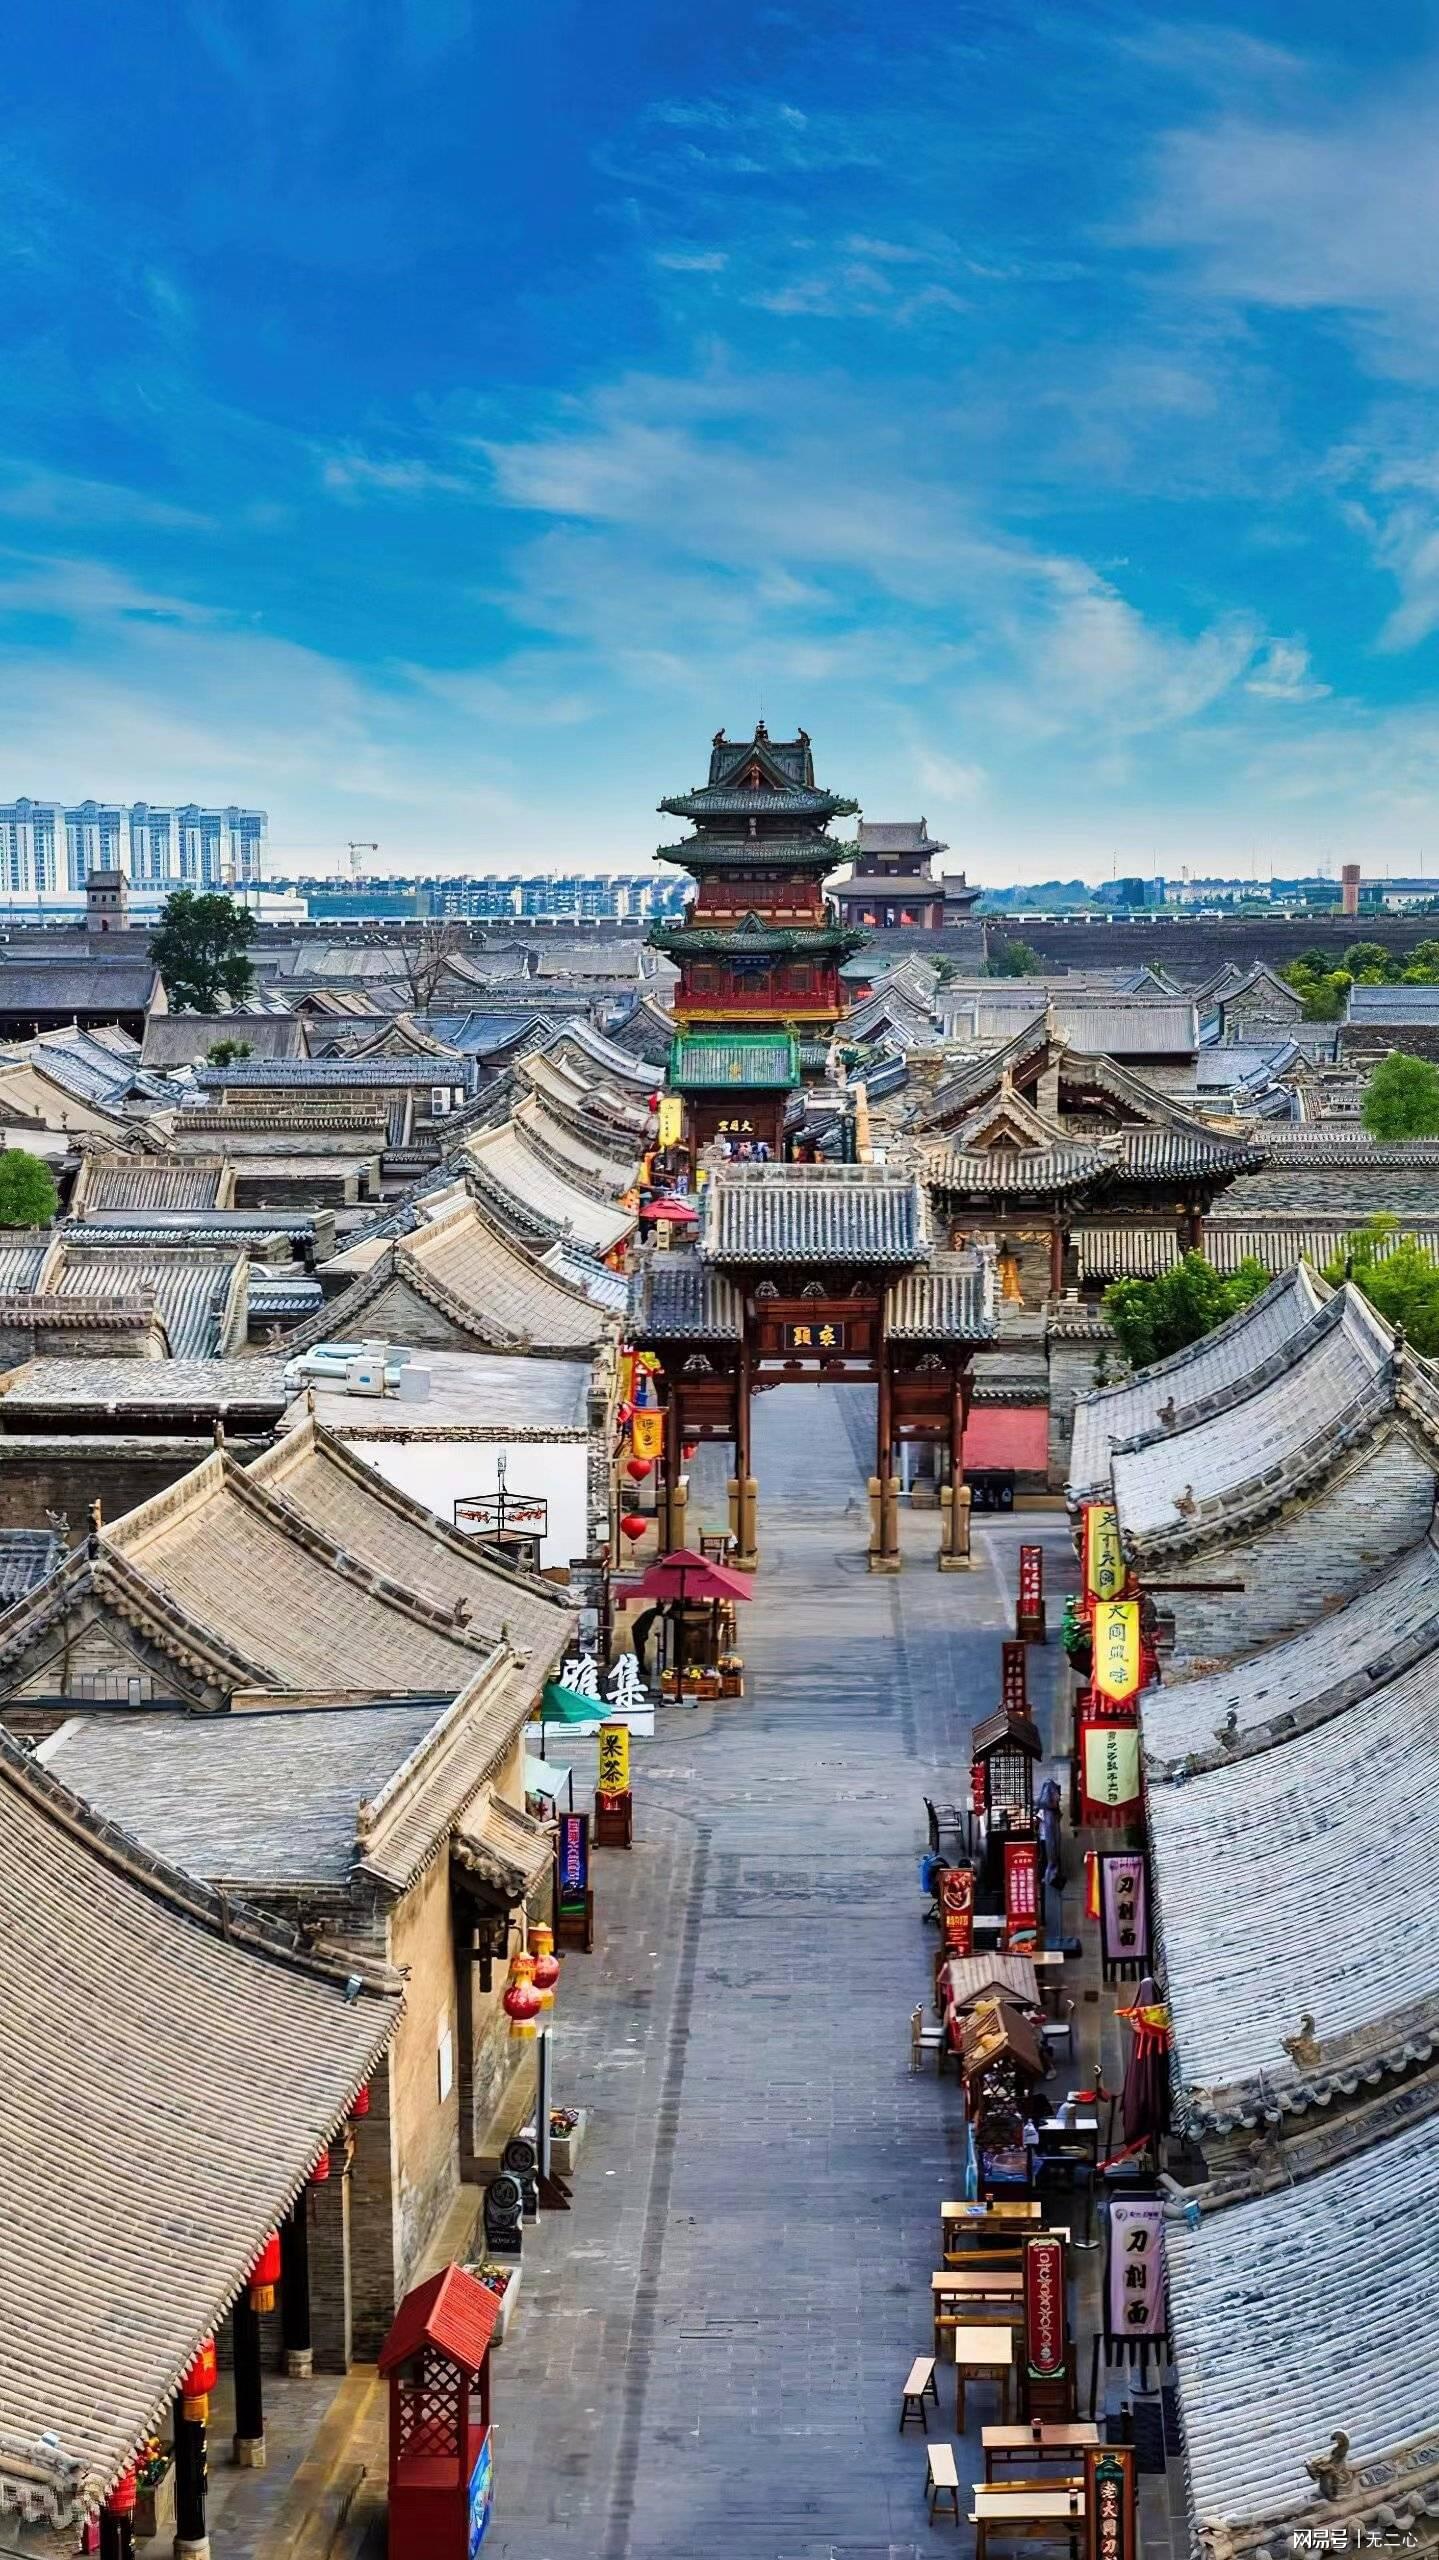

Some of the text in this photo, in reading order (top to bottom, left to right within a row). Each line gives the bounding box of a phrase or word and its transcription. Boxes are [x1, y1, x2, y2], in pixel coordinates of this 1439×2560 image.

[559, 1652, 649, 1709] 雅集
[600, 1734, 624, 1784] 果茶
[1125, 2230, 1150, 2325] 刀削面
[1101, 2480, 1118, 2560] 老大同刀
